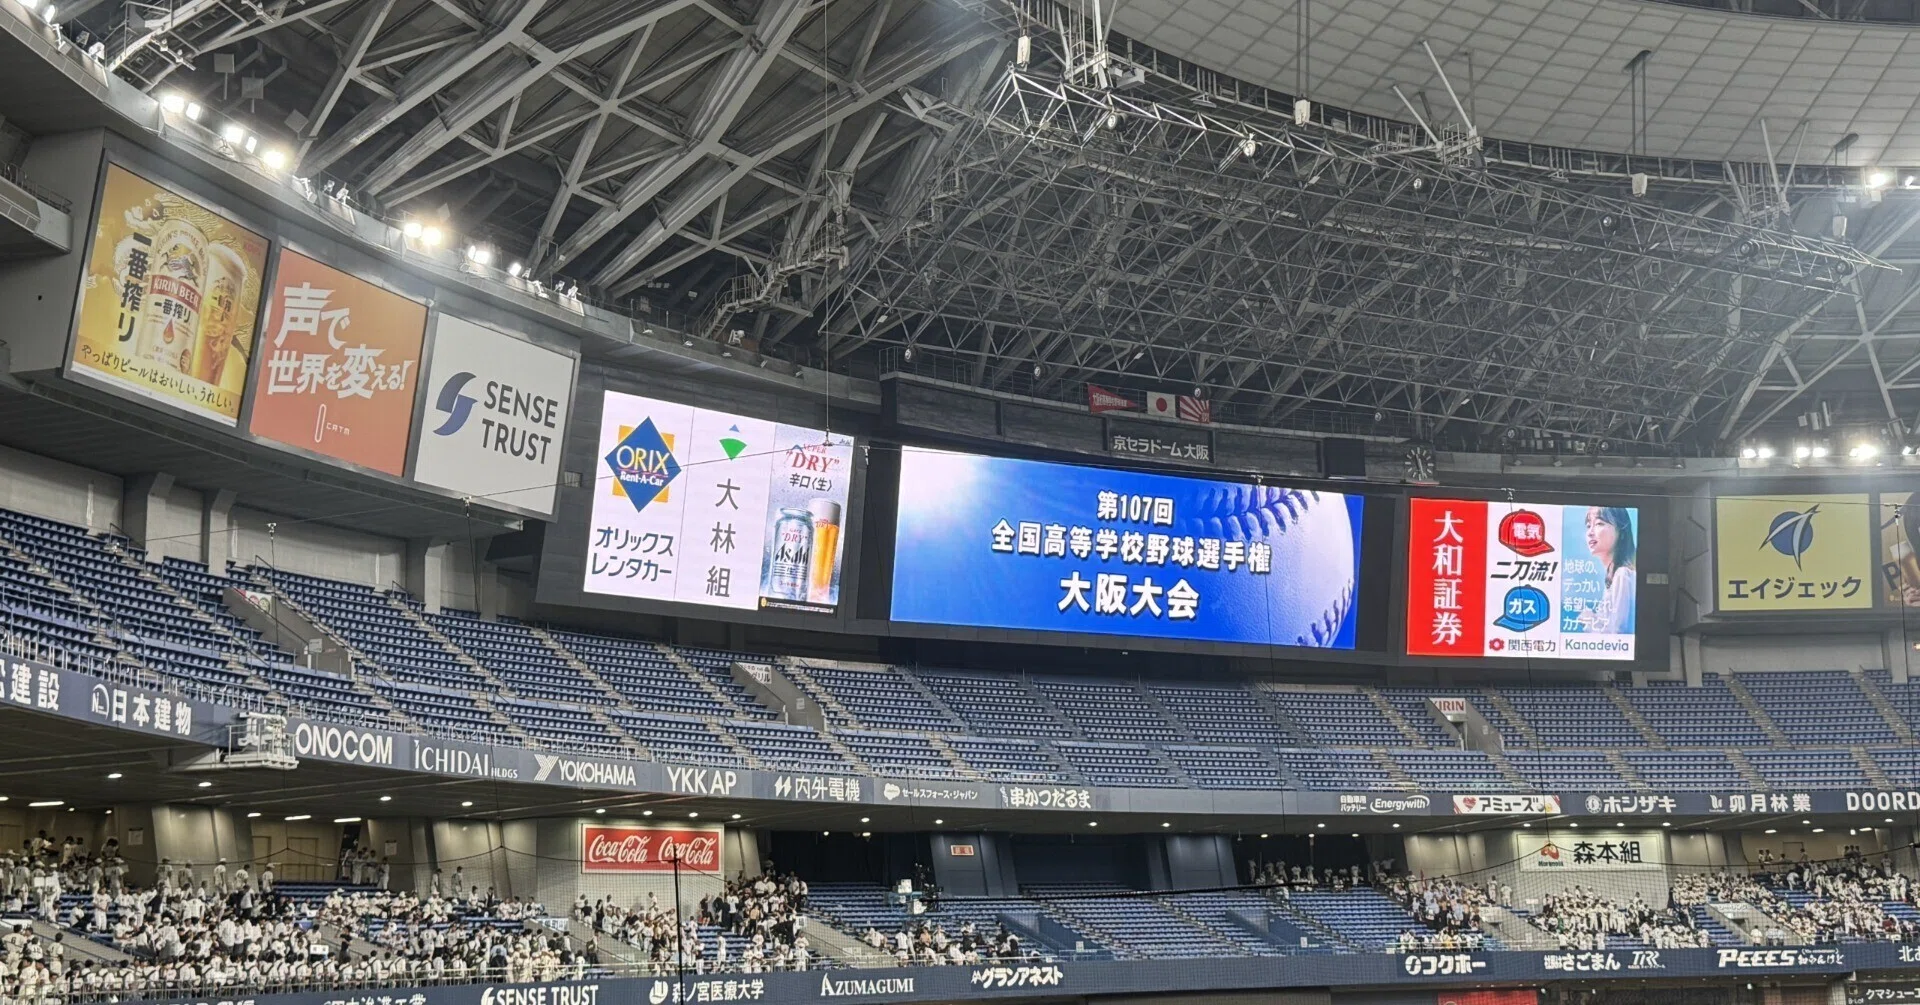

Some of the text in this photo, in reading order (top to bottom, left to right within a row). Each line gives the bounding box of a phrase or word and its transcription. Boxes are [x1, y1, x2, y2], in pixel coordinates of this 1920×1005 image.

[117, 232, 152, 342] 一番搾り
[153, 278, 202, 304] KIRIN BEER
[154, 299, 191, 324] 一番搾り
[274, 282, 350, 350] 声で
[81, 344, 235, 412] やっぱりビールはおいしい、うれしい。
[267, 344, 416, 400] 世界を変える!
[483, 380, 559, 429] SENSE
[482, 417, 552, 465] TRUST
[1113, 435, 1210, 461] 京セラドーム大阪
[616, 445, 671, 476] ORIX
[620, 470, 664, 488] Rent-A-Car
[1097, 490, 1174, 526] 第107回
[594, 526, 675, 558] オリックス
[706, 477, 741, 598] 大林組
[1513, 522, 1542, 540] 電気
[991, 518, 1272, 573] 全国高等学校野球選手権
[591, 551, 673, 583] レンタカー
[1431, 510, 1464, 646] 大和証券
[1490, 561, 1559, 582] 二刀流!
[1057, 571, 1200, 620] 大阪大会
[1728, 577, 1861, 600] エイジェック
[1509, 599, 1537, 615] ガス
[1508, 639, 1556, 653] 関西電力
[1565, 638, 1630, 652] Kanadevia
[0, 659, 60, 711] 建設
[112, 689, 192, 735] 日本建物
[295, 723, 393, 764] ONOCOM
[491, 768, 518, 779] HLDGS
[558, 760, 636, 786] YOKOHAMA
[667, 767, 737, 794] YKK AP
[795, 776, 860, 801] 内外電機
[902, 788, 978, 800] セールスフォース・ジャパン
[1010, 787, 1091, 808] 串かつだるま
[1374, 798, 1426, 811] Energywith
[1481, 797, 1538, 812] アミューズ
[1604, 796, 1676, 813] ホシザキ
[1729, 794, 1811, 813] 卯月林業
[589, 834, 717, 865] Coca-Cola Coca-Cola
[1573, 841, 1642, 864] 森本組
[1421, 954, 1486, 975] コクホー
[672, 979, 764, 1002] 森ノ宮医療大学
[820, 973, 914, 996] AZUMAGUMI
[982, 967, 1064, 989] グランアネスト
[496, 985, 599, 1005] SENSE TRUST
